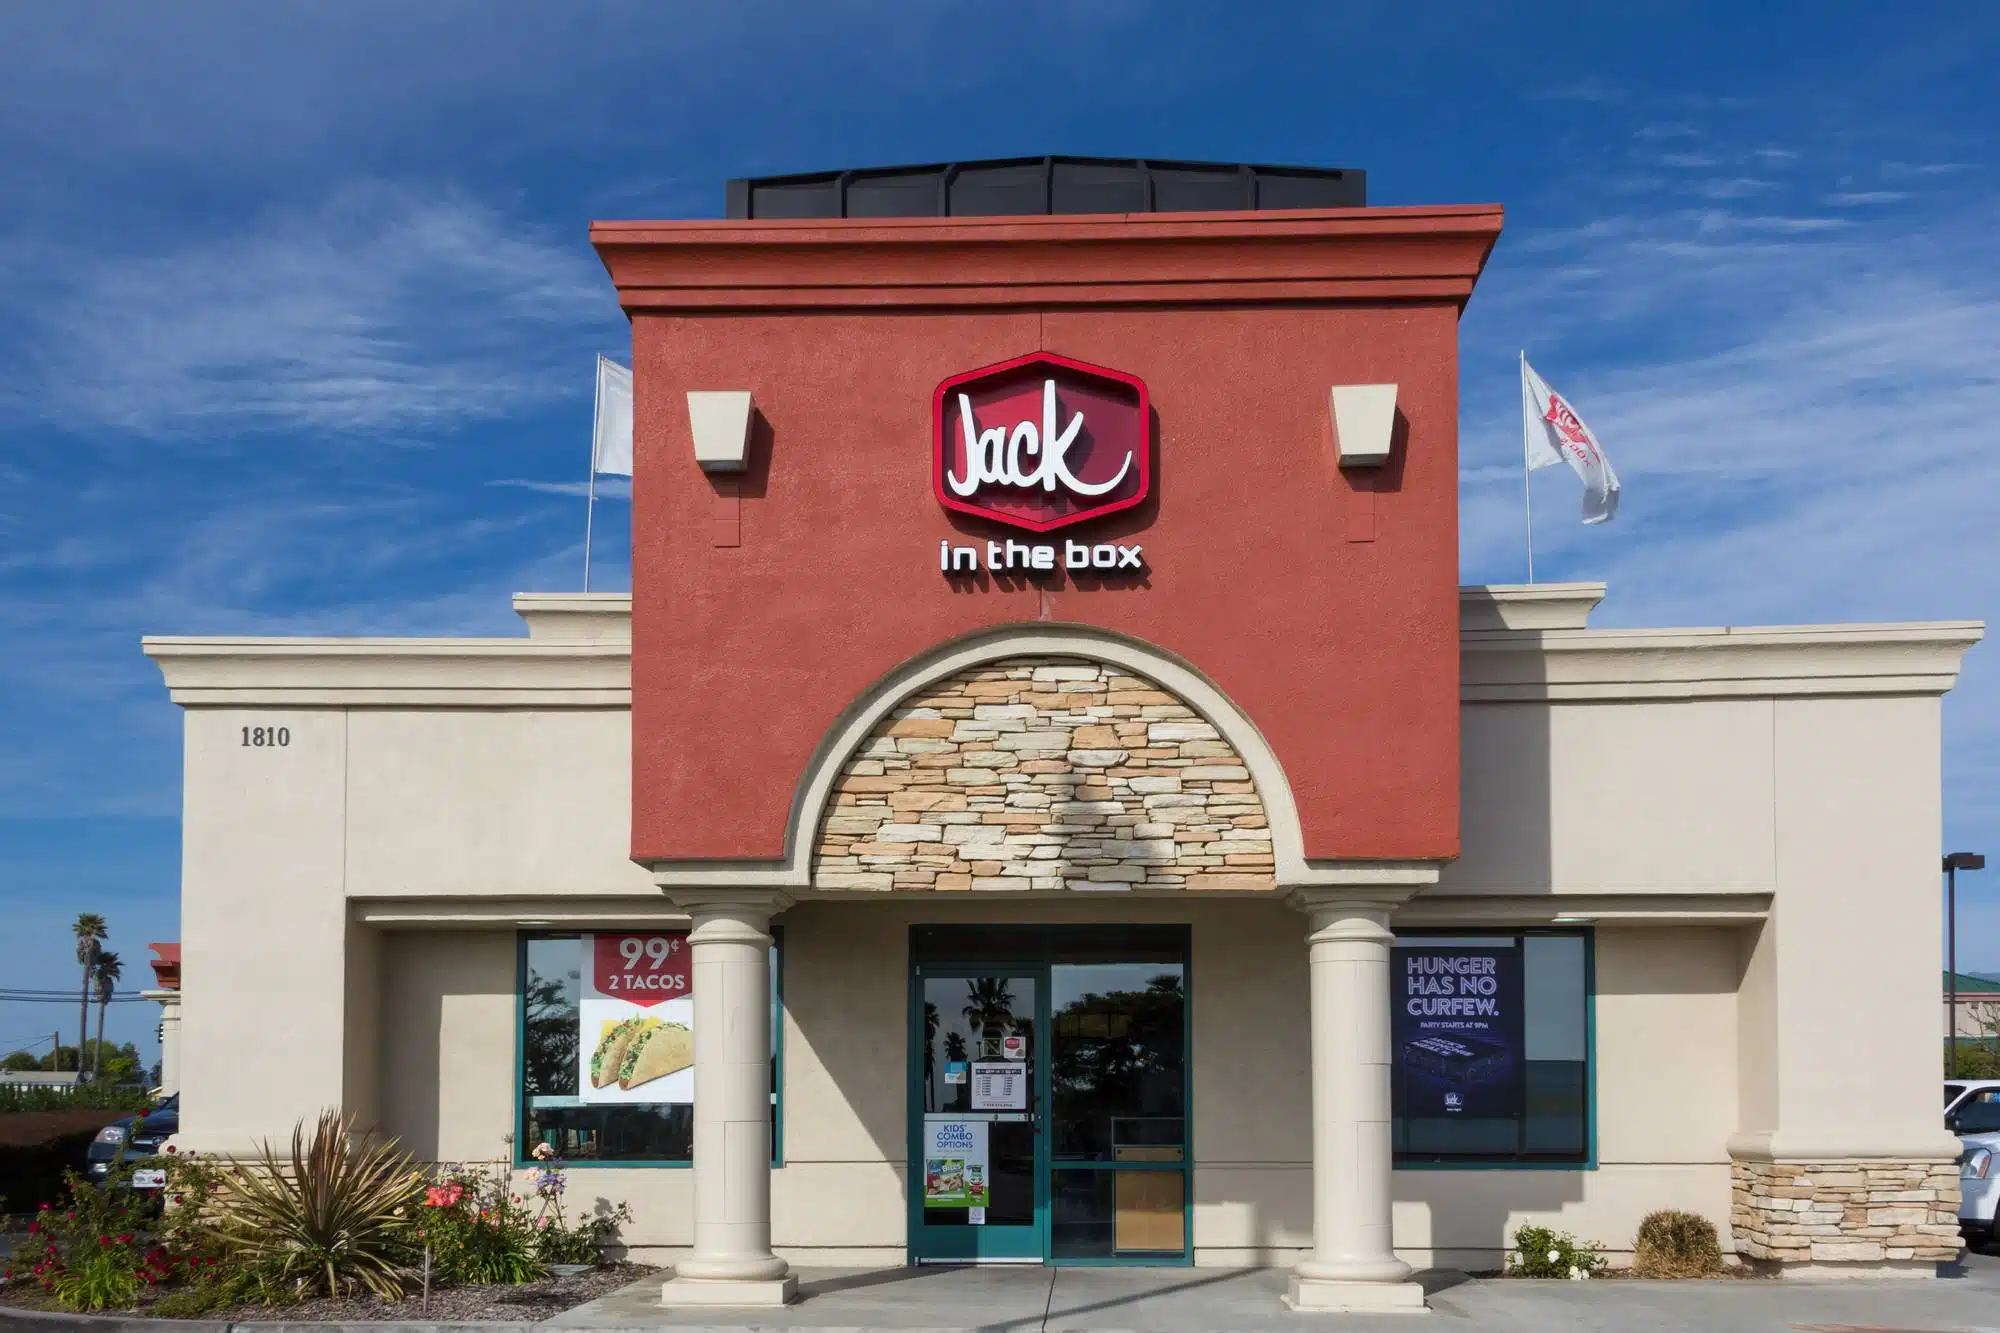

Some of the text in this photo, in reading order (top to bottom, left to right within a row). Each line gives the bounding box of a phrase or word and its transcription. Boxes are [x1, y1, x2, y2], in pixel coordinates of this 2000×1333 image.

[947, 379, 1132, 497] Jack
[940, 539, 1143, 571] in the box
[241, 726, 290, 747] 1810
[1407, 956, 1496, 975] HUNGER
[608, 974, 685, 990] 2 TACOS
[1408, 976, 1497, 996] HAS NO
[1407, 997, 1500, 1017] CURFEW.
[1420, 1021, 1440, 1029] PARTY
[1441, 1021, 1464, 1029] STARTS
[1465, 1021, 1473, 1029] AT
[936, 1132, 973, 1140] COMBO
[936, 1141, 974, 1149] OPTIONS
